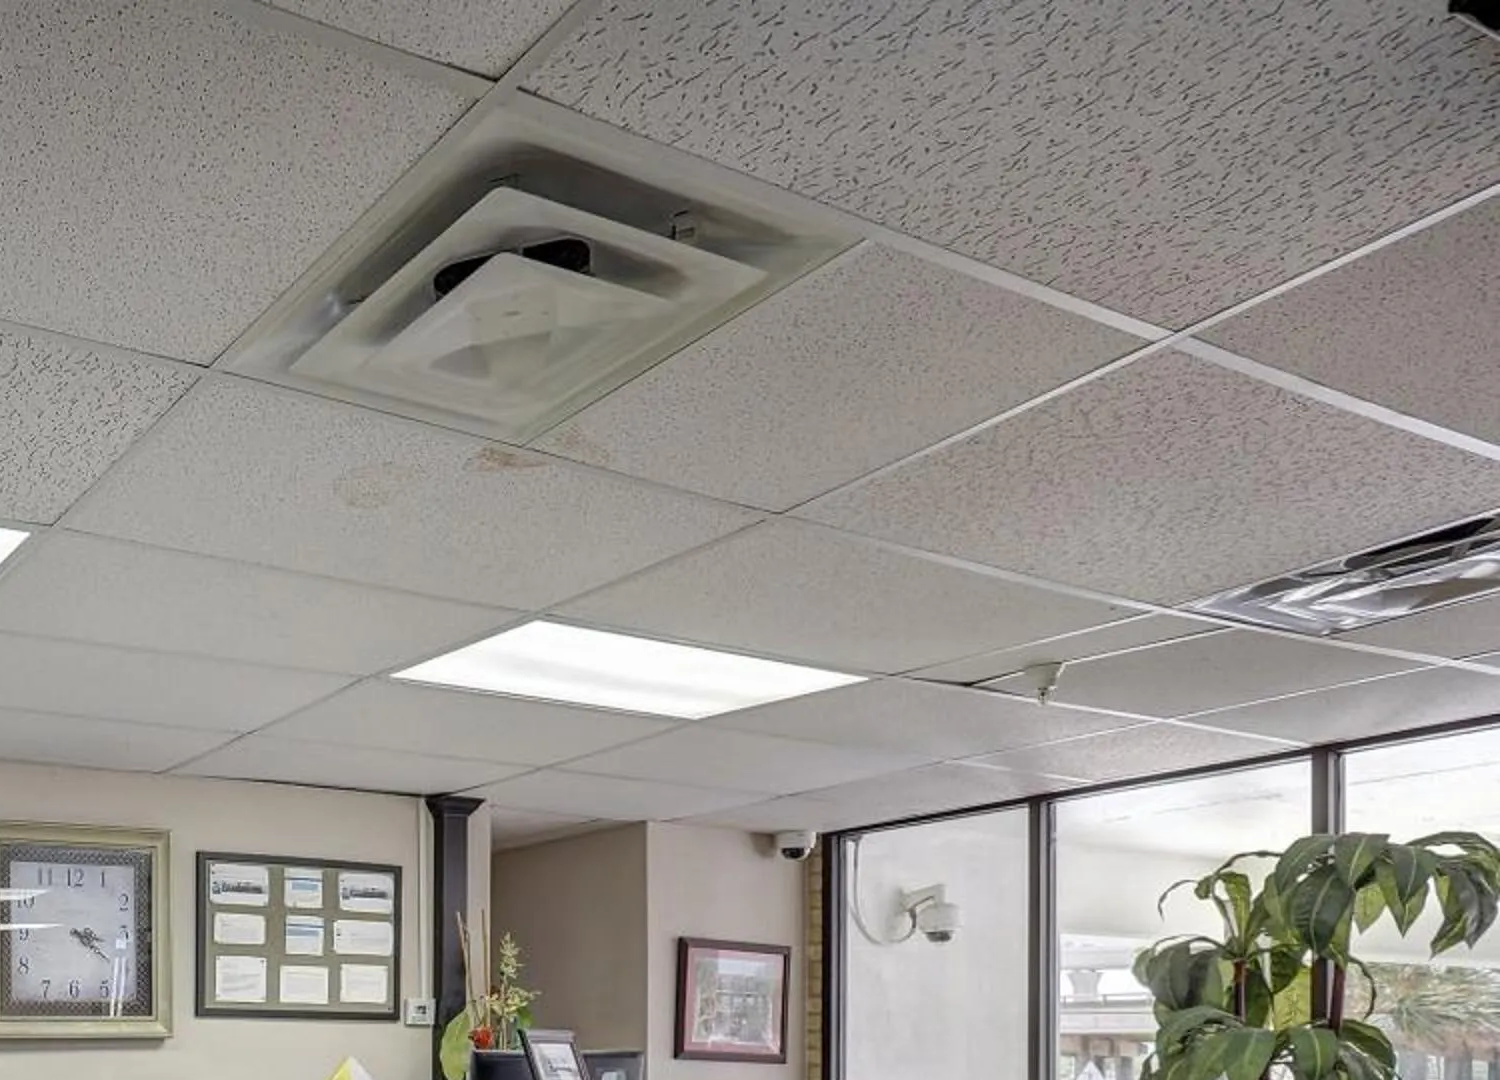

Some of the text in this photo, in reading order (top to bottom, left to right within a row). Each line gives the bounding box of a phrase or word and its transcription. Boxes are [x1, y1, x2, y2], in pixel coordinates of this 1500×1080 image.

[67, 868, 84, 888] 12
[118, 893, 129, 911] 2
[18, 956, 29, 975] 8
[41, 979, 51, 999] 7
[68, 978, 81, 998] 6
[99, 979, 109, 998] 5
